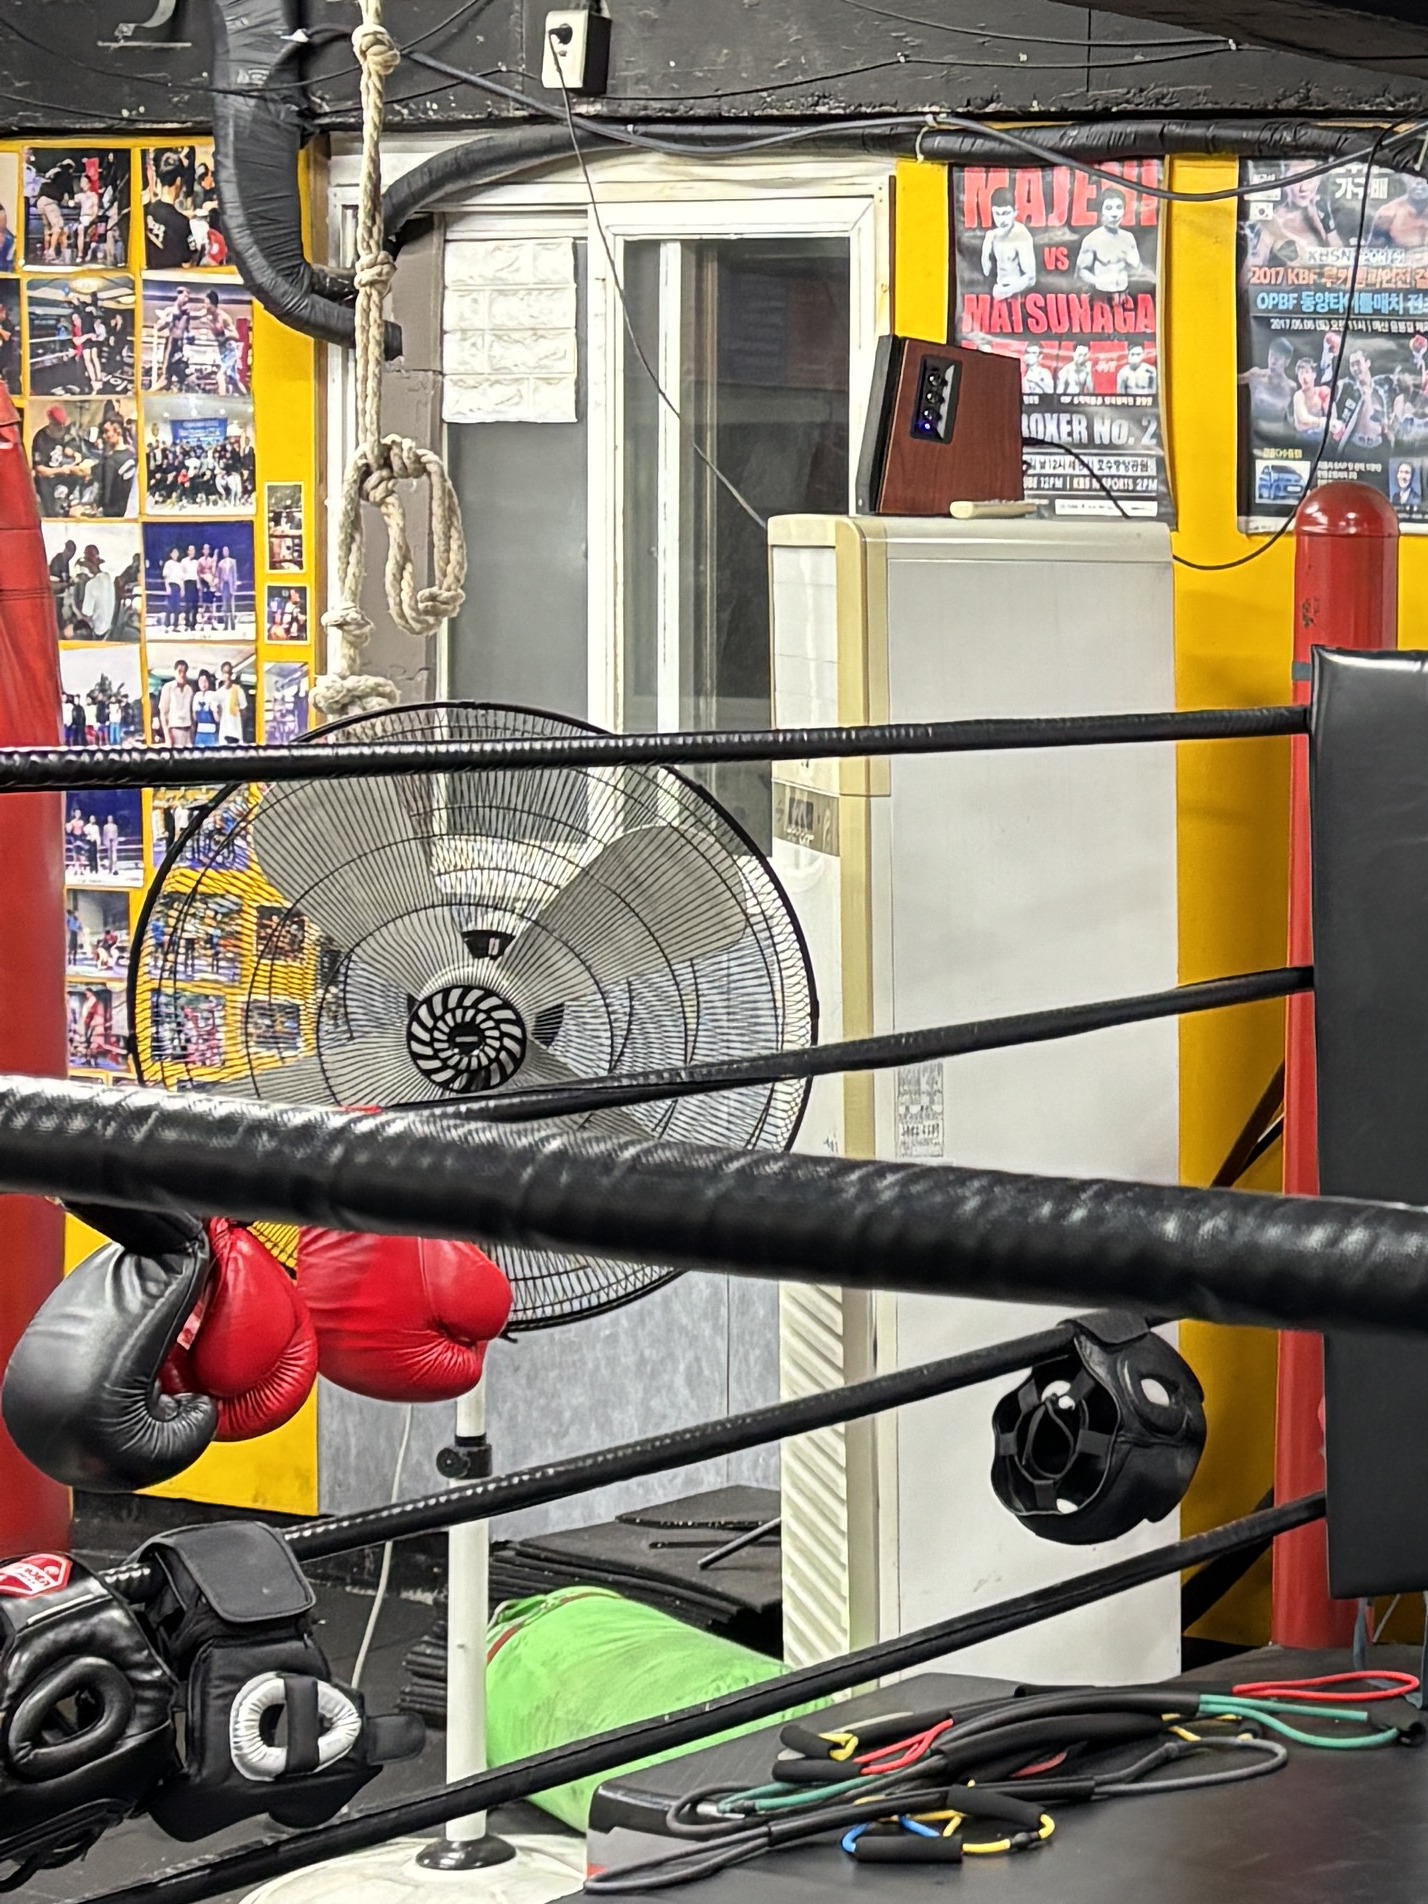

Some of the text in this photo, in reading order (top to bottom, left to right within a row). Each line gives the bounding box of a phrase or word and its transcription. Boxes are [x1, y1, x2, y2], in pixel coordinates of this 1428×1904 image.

[1043, 246, 1069, 271] VS
[1250, 267, 1283, 285] 2017
[1286, 268, 1318, 286] KBF
[961, 293, 1156, 334] MATSUNAGA
[1256, 292, 1298, 310] OPBF
[1141, 416, 1158, 446] 2
